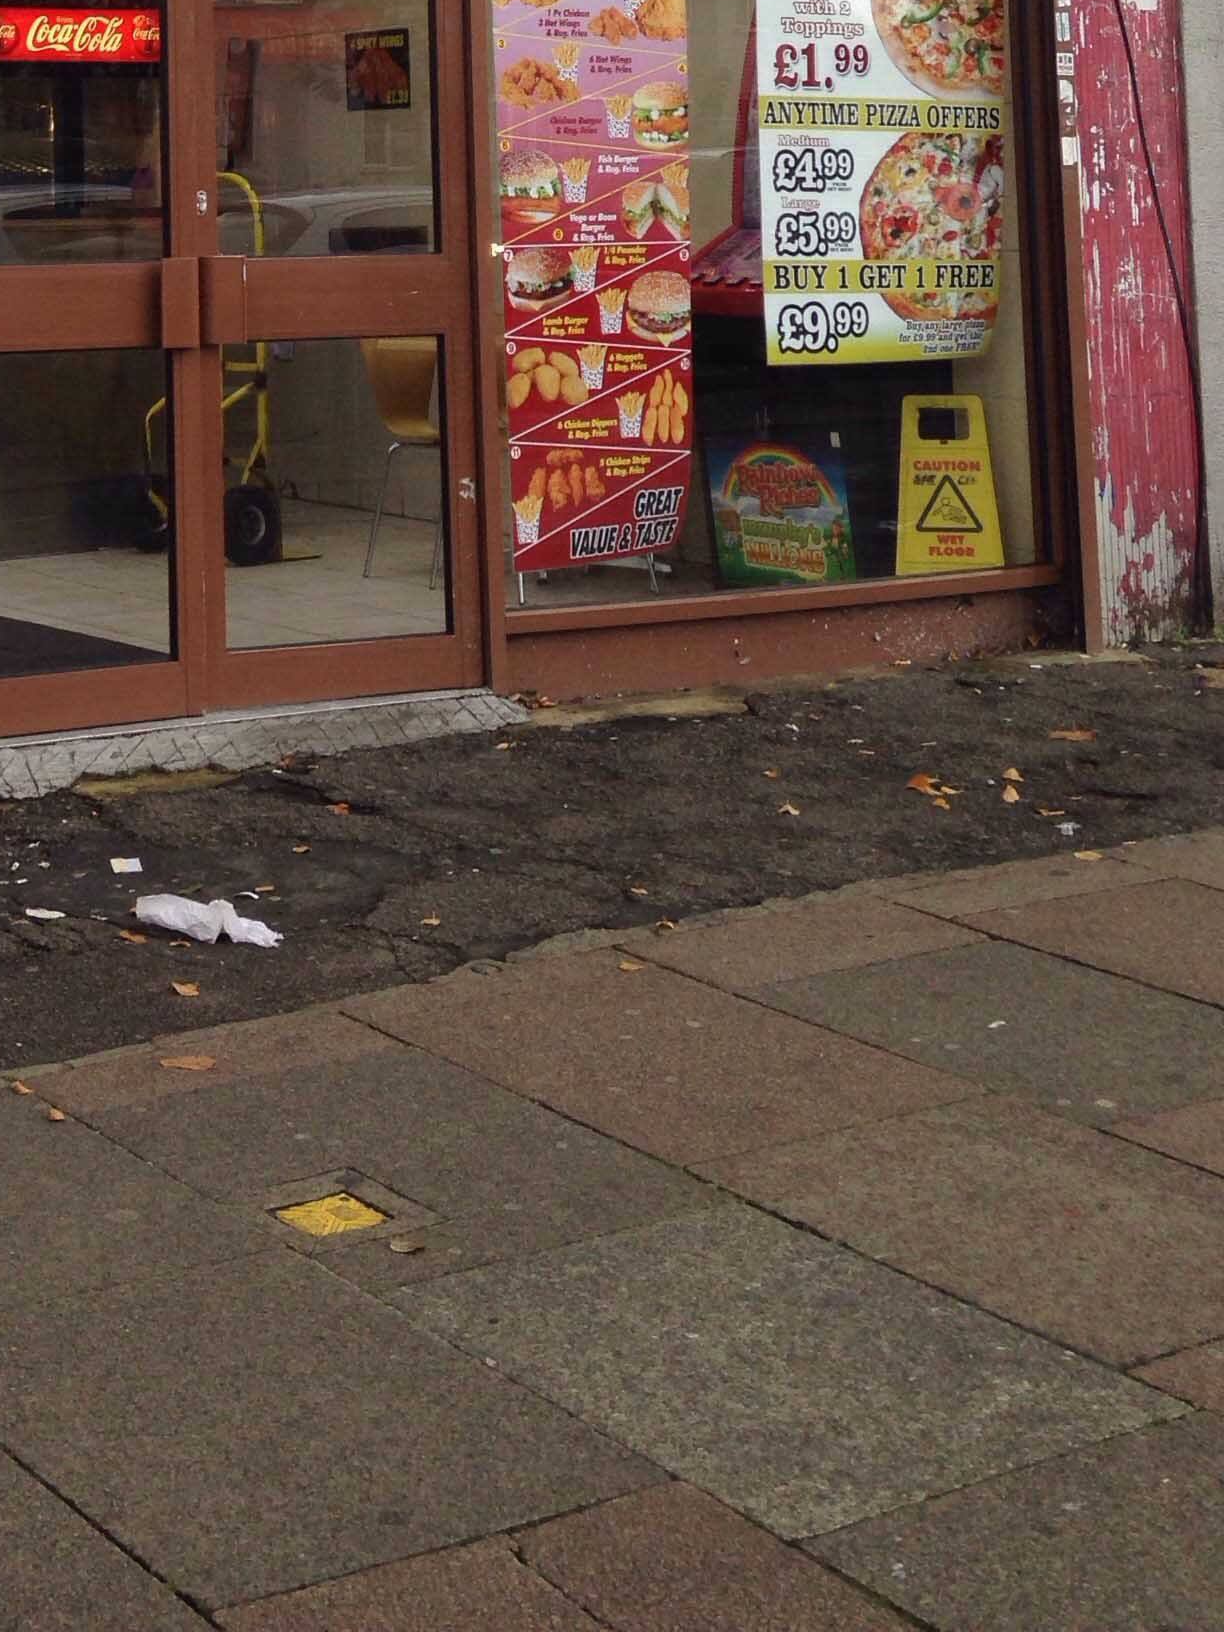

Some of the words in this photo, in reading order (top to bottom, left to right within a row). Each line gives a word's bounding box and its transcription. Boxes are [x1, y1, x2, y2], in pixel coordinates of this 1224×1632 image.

[839, 1, 851, 16] 2
[26, 16, 123, 52] Coca-Cola
[781, 17, 864, 38] Toppings
[774, 42, 871, 90] £1.99
[764, 101, 859, 126] ANYTIME
[865, 104, 921, 127] PIZZA
[927, 105, 1000, 130] OFFERS
[777, 134, 830, 147] Medium
[773, 149, 854, 193] £4.99
[781, 197, 820, 211] Large
[775, 212, 856, 256] £5.99
[773, 265, 827, 289] BUY
[838, 265, 849, 289] 1
[859, 265, 907, 289] GET
[916, 265, 925, 288] 1
[935, 265, 995, 288] FREE
[778, 301, 869, 353] £9.99
[512, 448, 520, 458] 11
[913, 460, 982, 471] CAUTION
[634, 486, 684, 518] GREAT
[570, 526, 617, 559] VALUE
[618, 523, 633, 552] &
[633, 517, 678, 550] TASTE
[937, 534, 965, 544] WET
[928, 546, 975, 557] FLOOR
